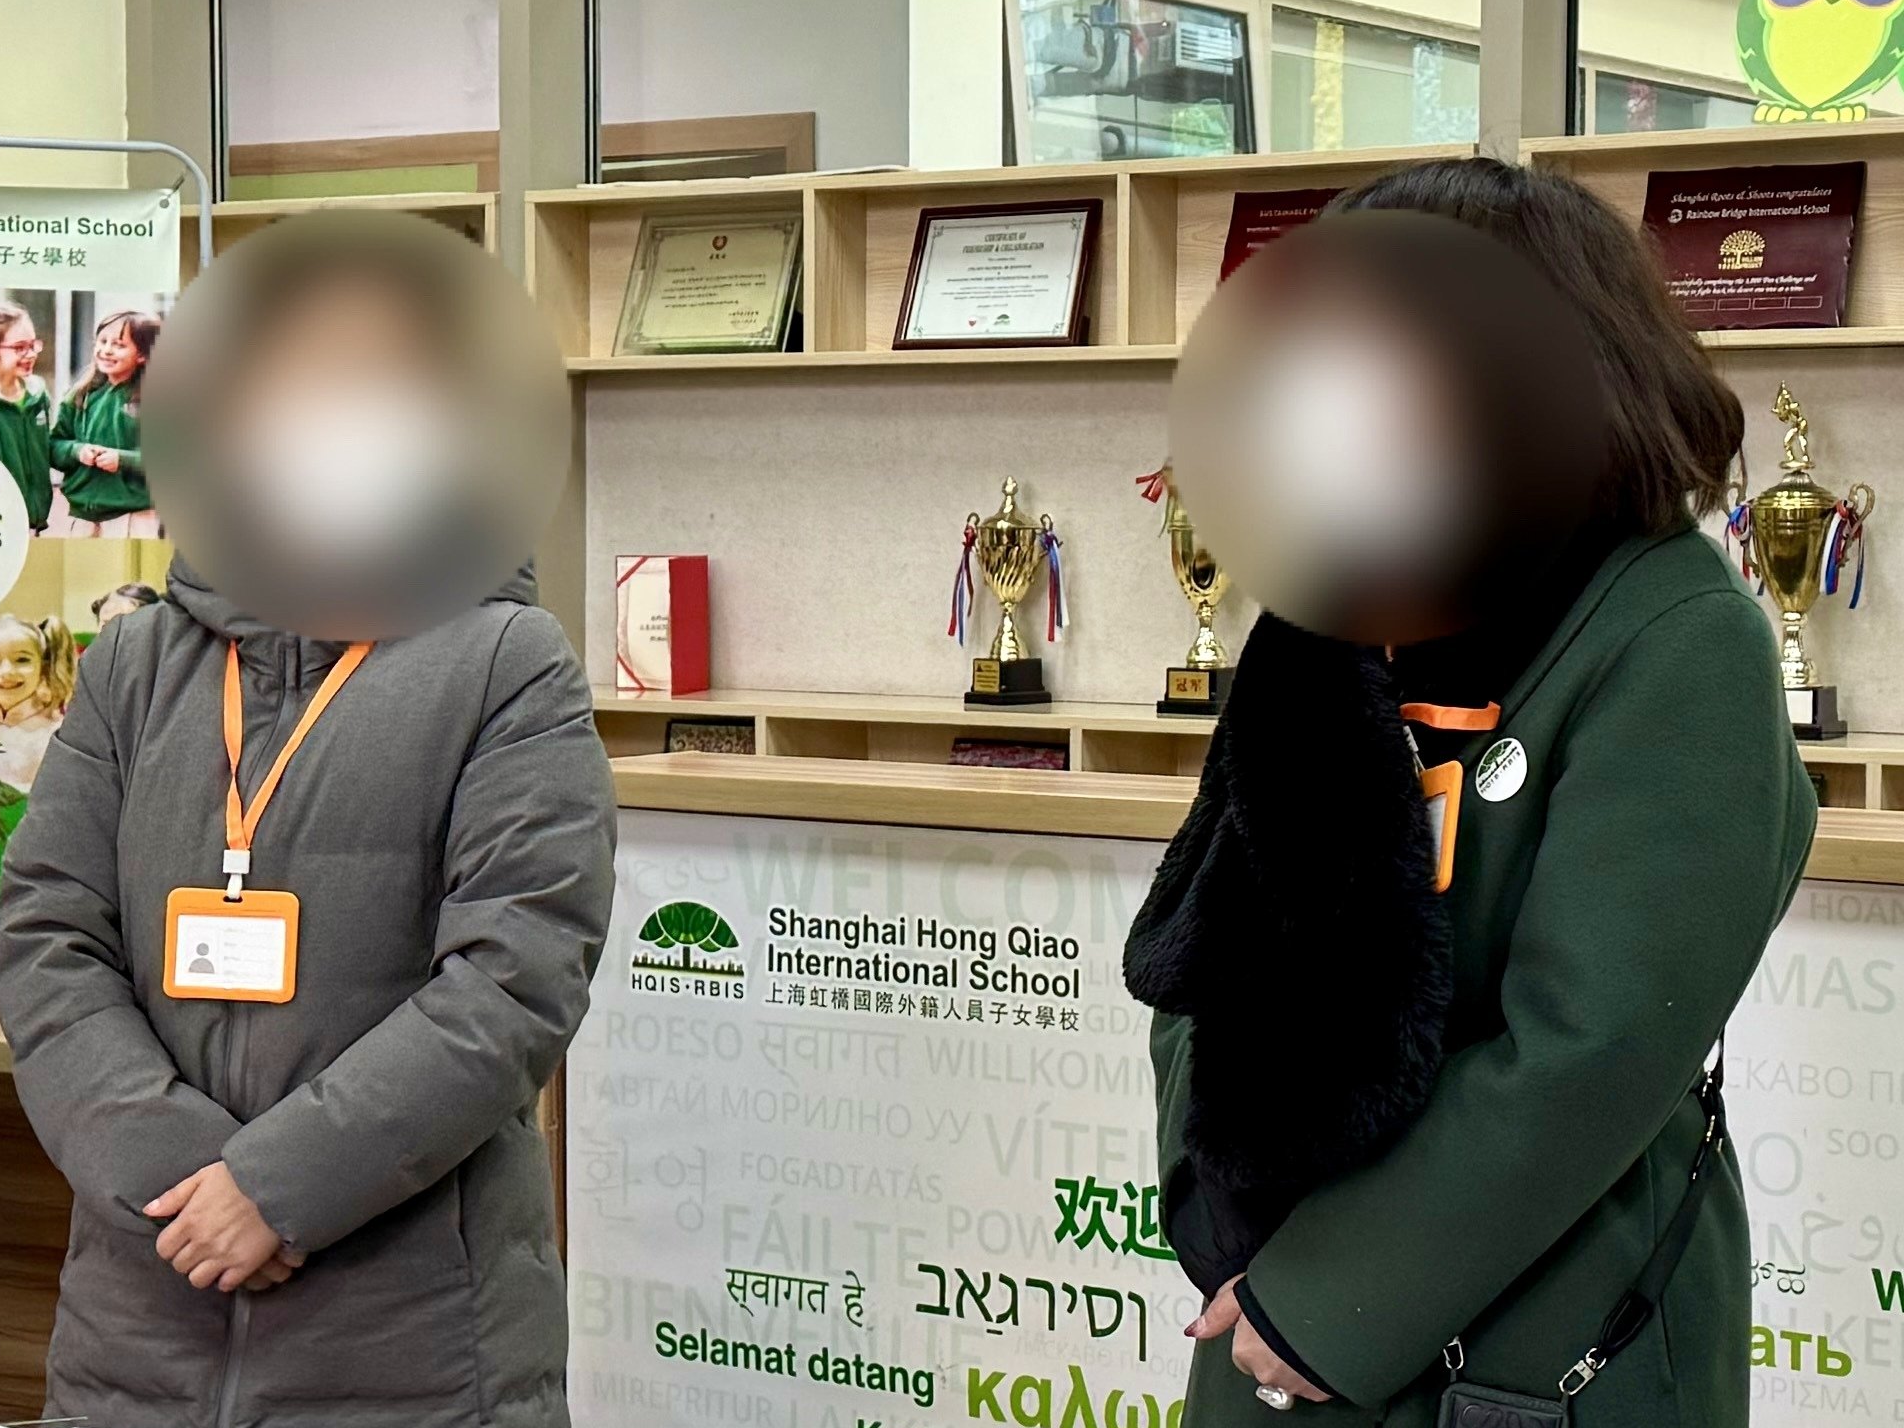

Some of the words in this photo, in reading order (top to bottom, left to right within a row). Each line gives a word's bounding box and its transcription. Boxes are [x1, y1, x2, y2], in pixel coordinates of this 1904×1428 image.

[77, 216, 154, 238] School
[1686, 208, 1720, 220] Rainbow
[1721, 207, 1747, 219] Bridge
[1748, 205, 1802, 217] International
[1802, 203, 1831, 215] School
[767, 907, 907, 950] Shanghai
[916, 918, 997, 960] Hong
[1007, 926, 1080, 961] Qiao
[766, 943, 960, 991] International
[969, 958, 1080, 999] School
[765, 982, 1081, 1032] 上海虹橋國際外籍人員子女學校
[1825, 1127, 1898, 1161] SOO
[655, 1319, 797, 1378] Selamat
[808, 1345, 935, 1408] datang
